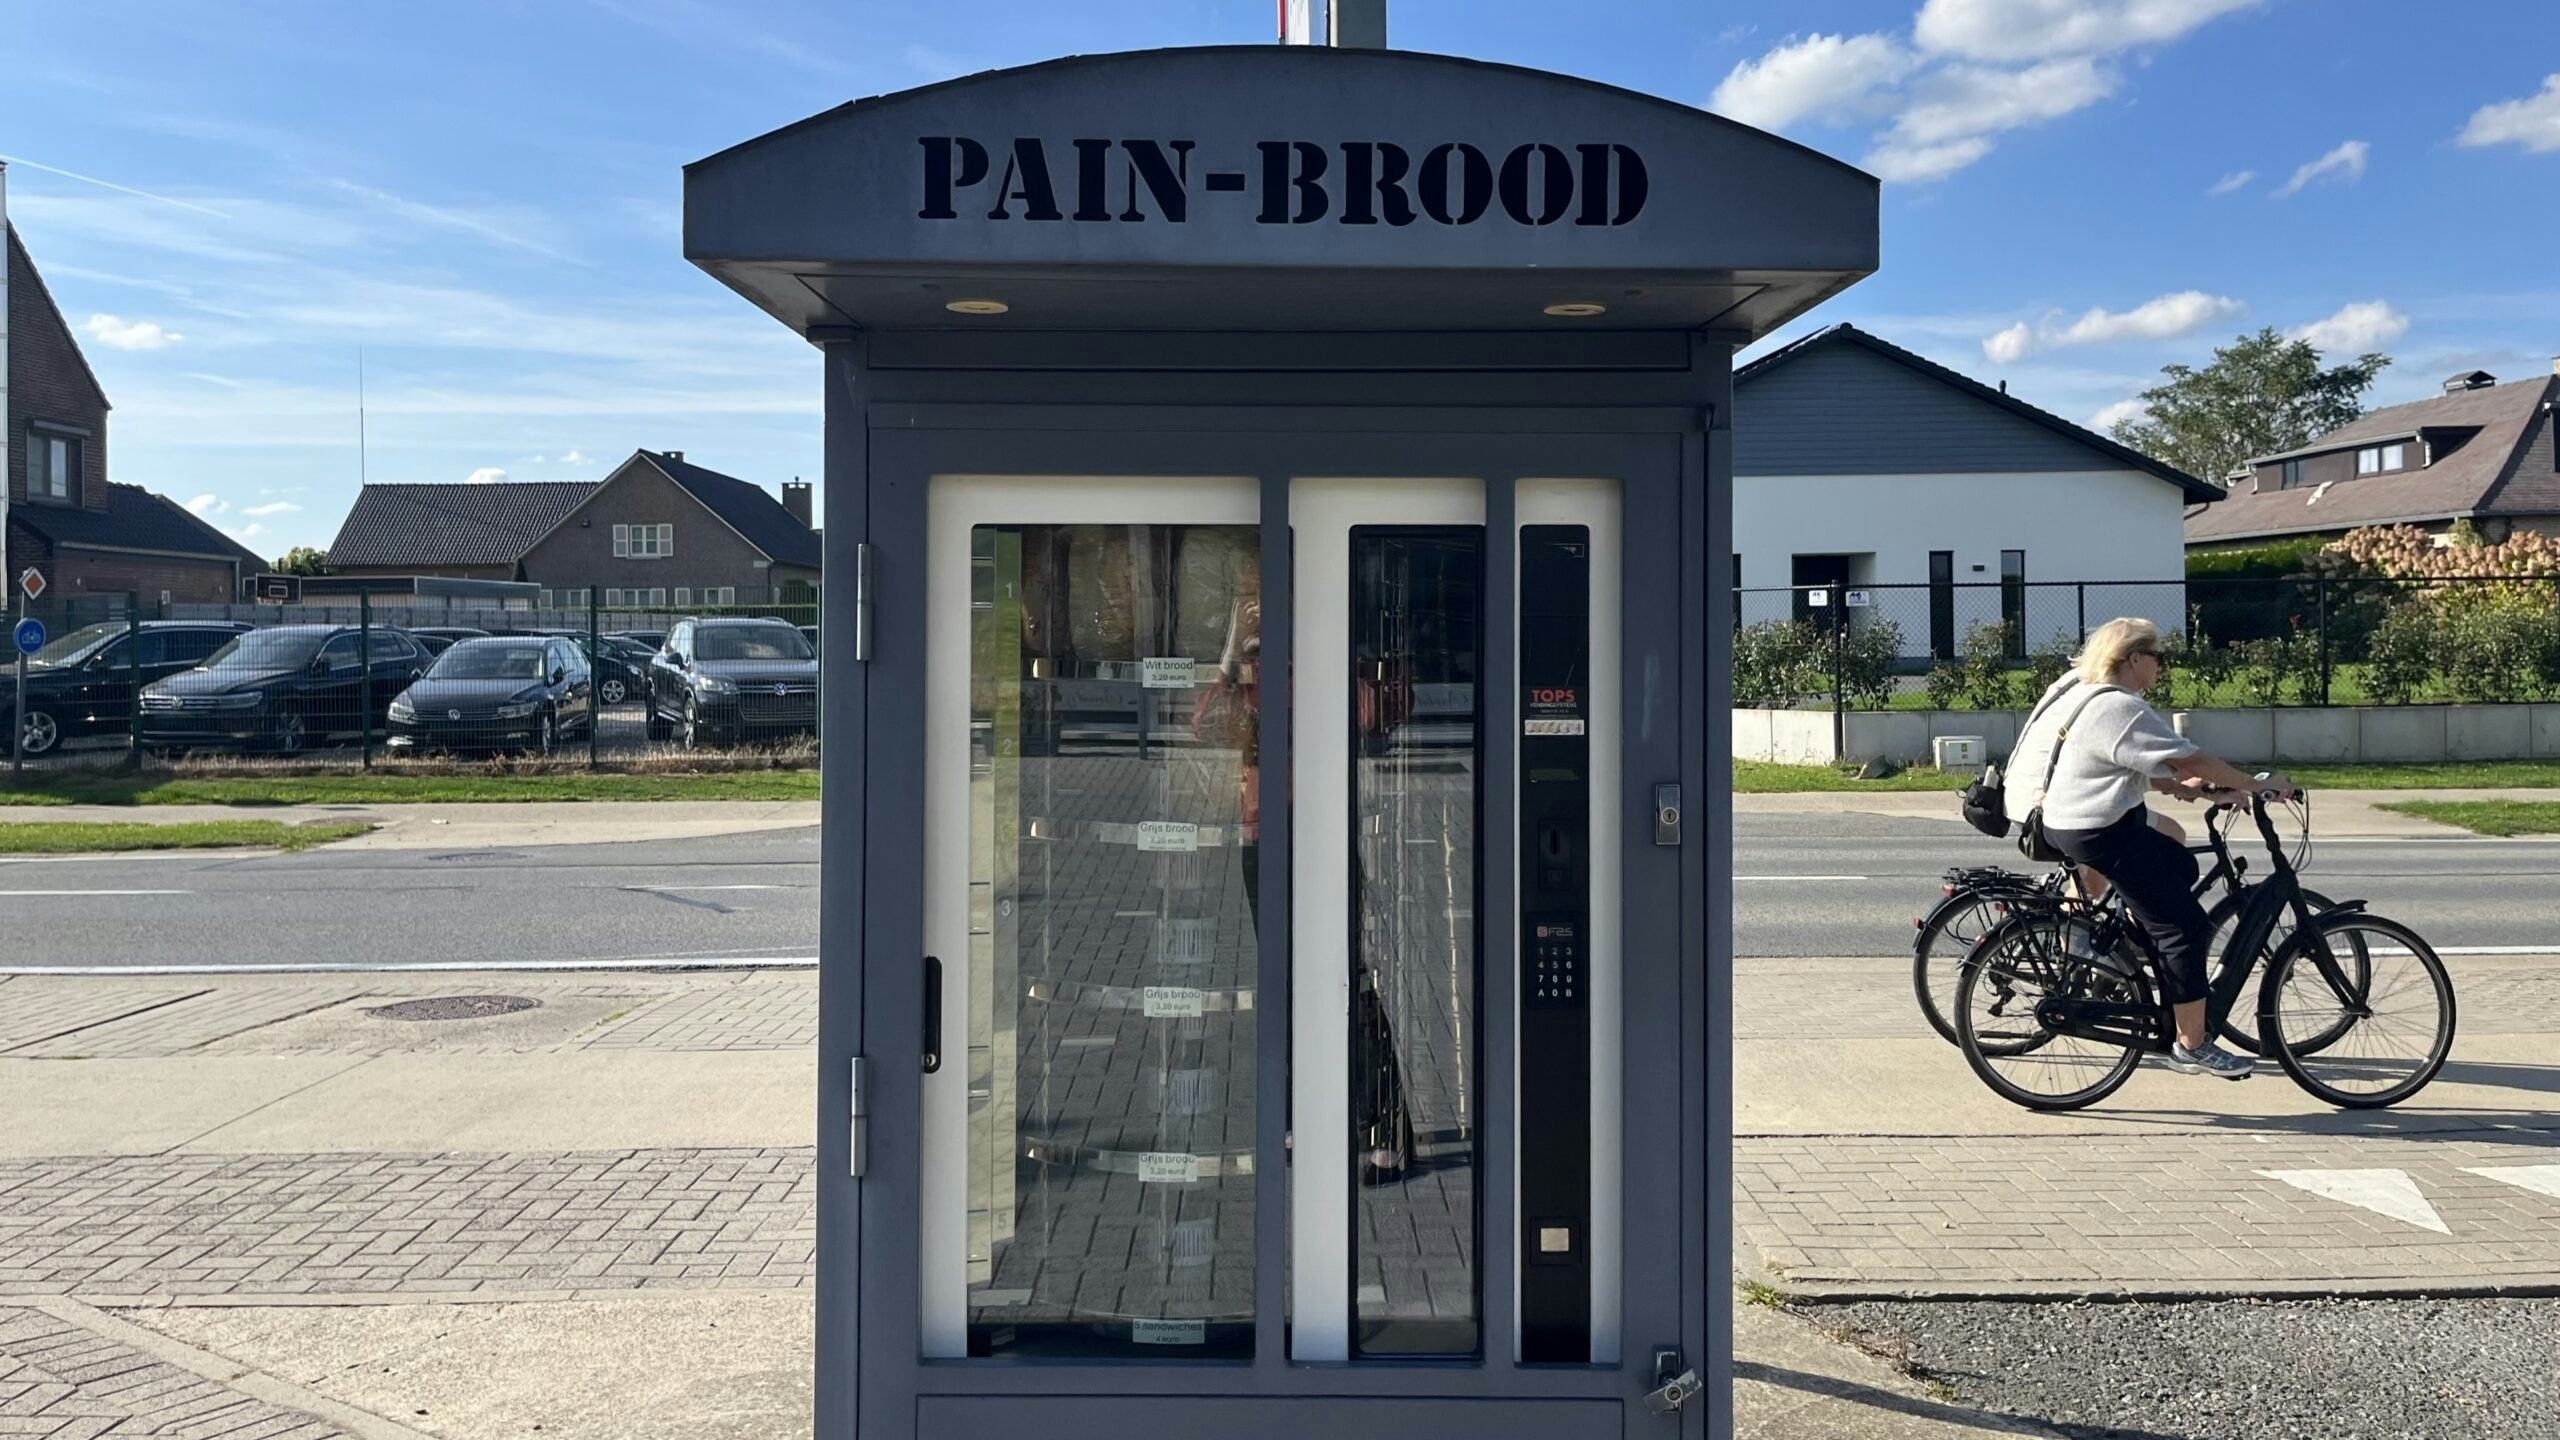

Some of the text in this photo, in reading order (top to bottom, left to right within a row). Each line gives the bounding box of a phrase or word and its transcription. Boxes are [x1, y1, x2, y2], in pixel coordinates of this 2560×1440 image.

[918, 136, 1648, 227] PAIN-BROOD
[1005, 582, 1013, 599] 1
[1145, 660, 1193, 670] Wit brood
[1532, 689, 1575, 702] TOPS
[1140, 823, 1163, 834] Grijs
[1002, 900, 1011, 917] 3
[1145, 989, 1168, 1000] Grijs
[1140, 1153, 1163, 1164] Grijs
[998, 1212, 1007, 1230] 5
